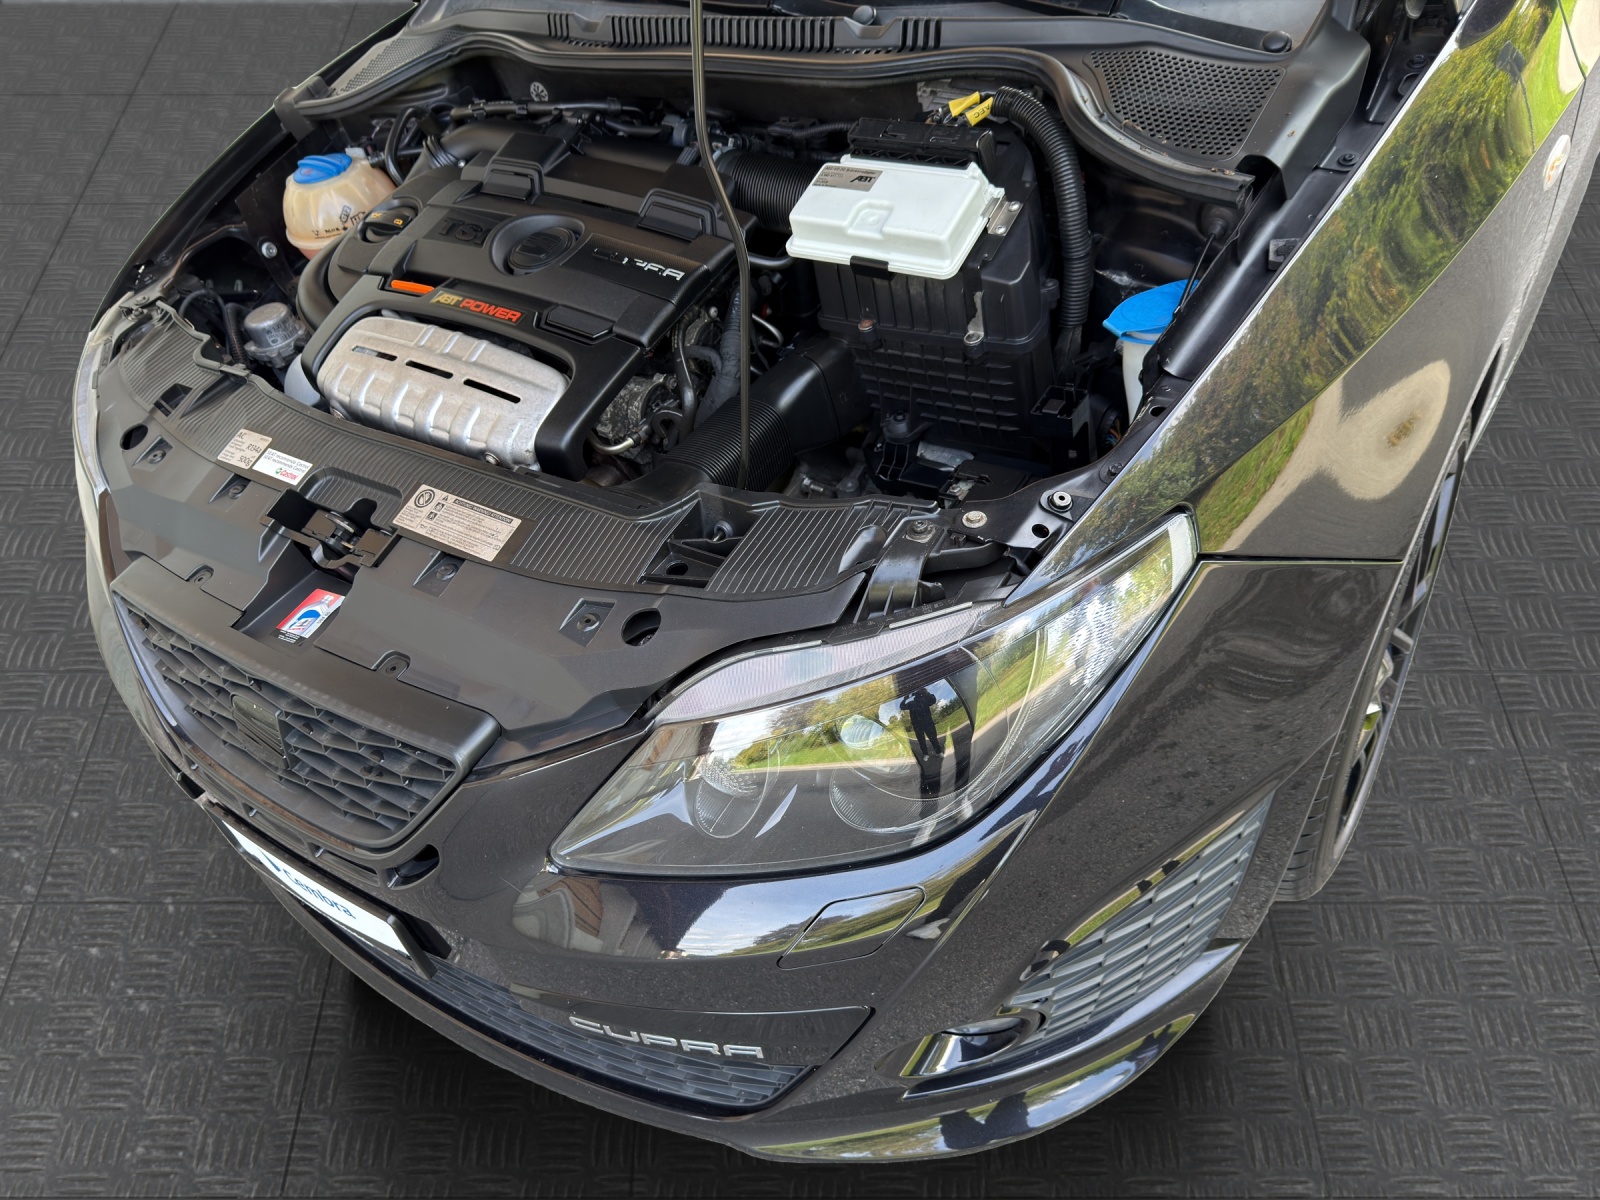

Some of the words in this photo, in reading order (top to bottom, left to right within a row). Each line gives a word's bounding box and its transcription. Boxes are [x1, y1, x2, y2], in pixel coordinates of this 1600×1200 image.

[973, 103, 991, 119] AEC
[849, 175, 876, 183] ABT
[430, 292, 463, 305] ABT
[459, 298, 523, 322] POWER
[283, 868, 357, 920] cembra
[569, 1016, 765, 1059] CUPRA
